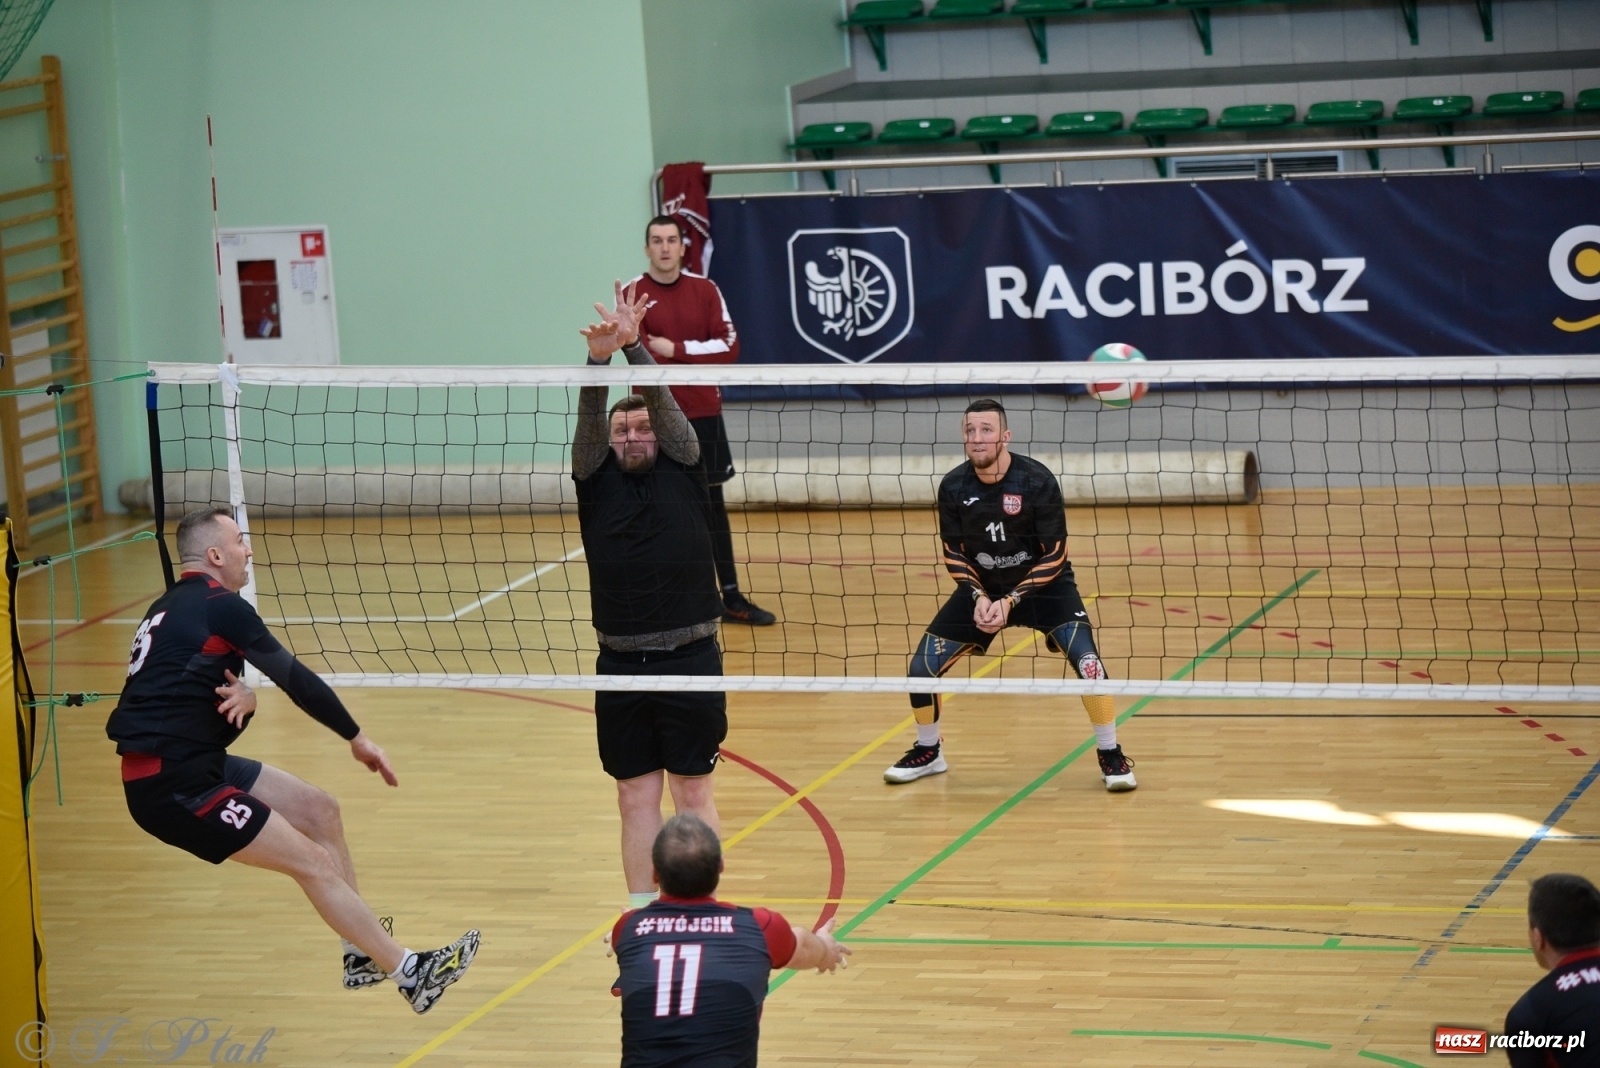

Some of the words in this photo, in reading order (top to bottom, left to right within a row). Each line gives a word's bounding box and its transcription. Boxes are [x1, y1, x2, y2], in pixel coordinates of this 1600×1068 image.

[985, 240, 1369, 319] RACIBÓRZ
[985, 521, 1006, 542] 11
[220, 798, 252, 829] 25
[653, 944, 702, 1017] 11
